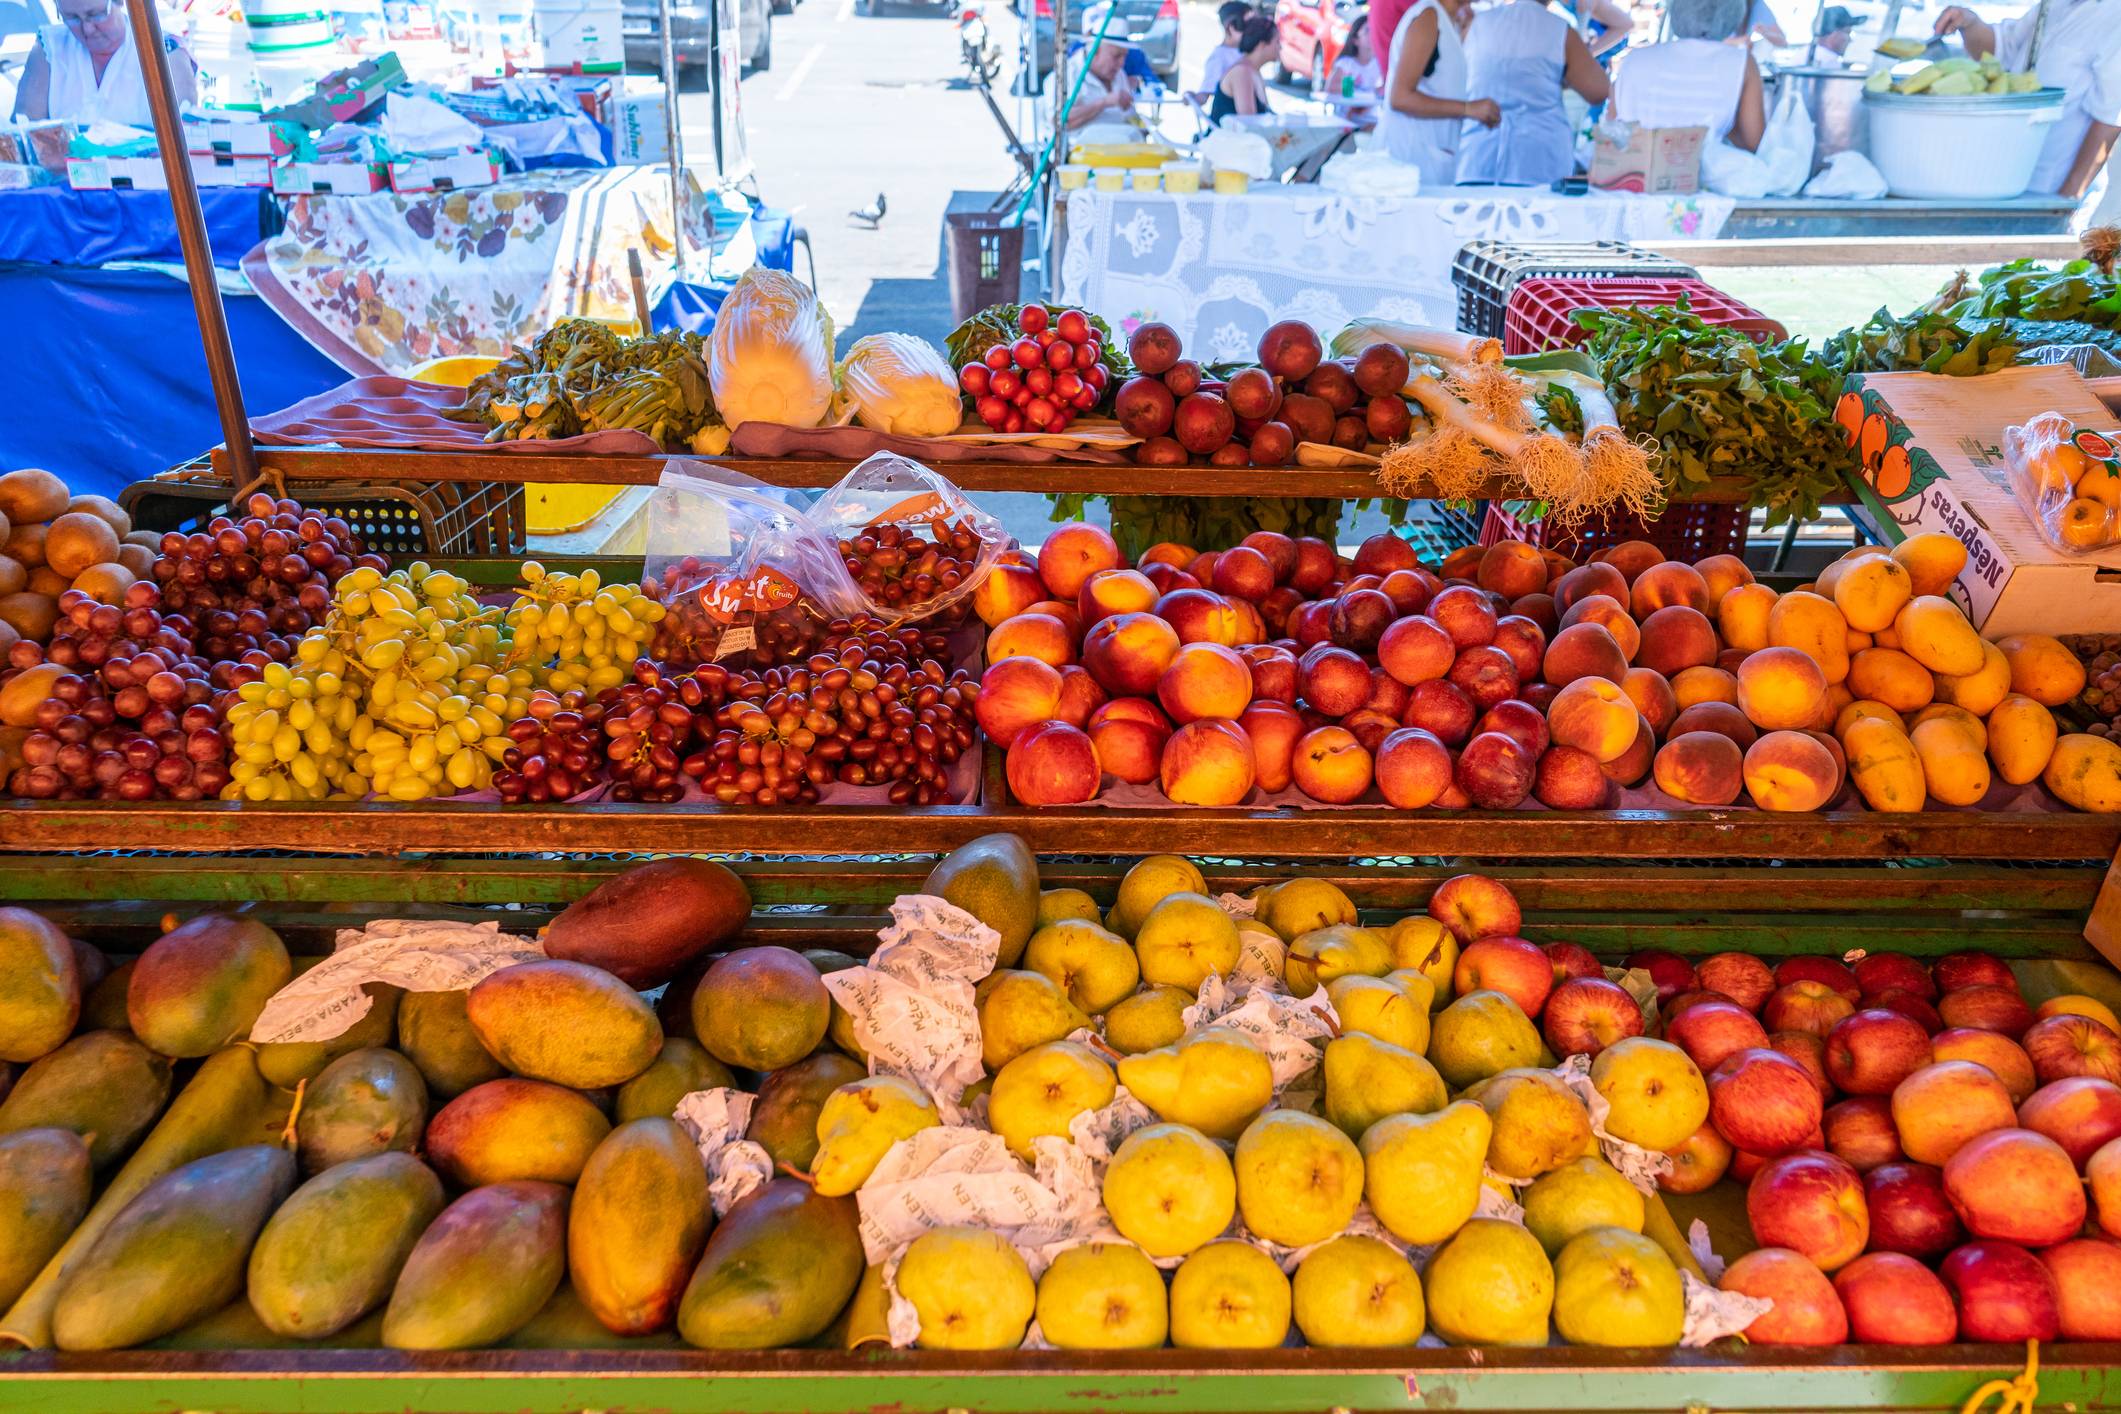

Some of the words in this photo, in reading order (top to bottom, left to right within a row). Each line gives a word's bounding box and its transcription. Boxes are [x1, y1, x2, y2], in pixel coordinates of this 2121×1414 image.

[626, 103, 641, 159] Sublime
[1931, 490, 2004, 589] Nêsperas
[775, 590, 794, 600] fruits
